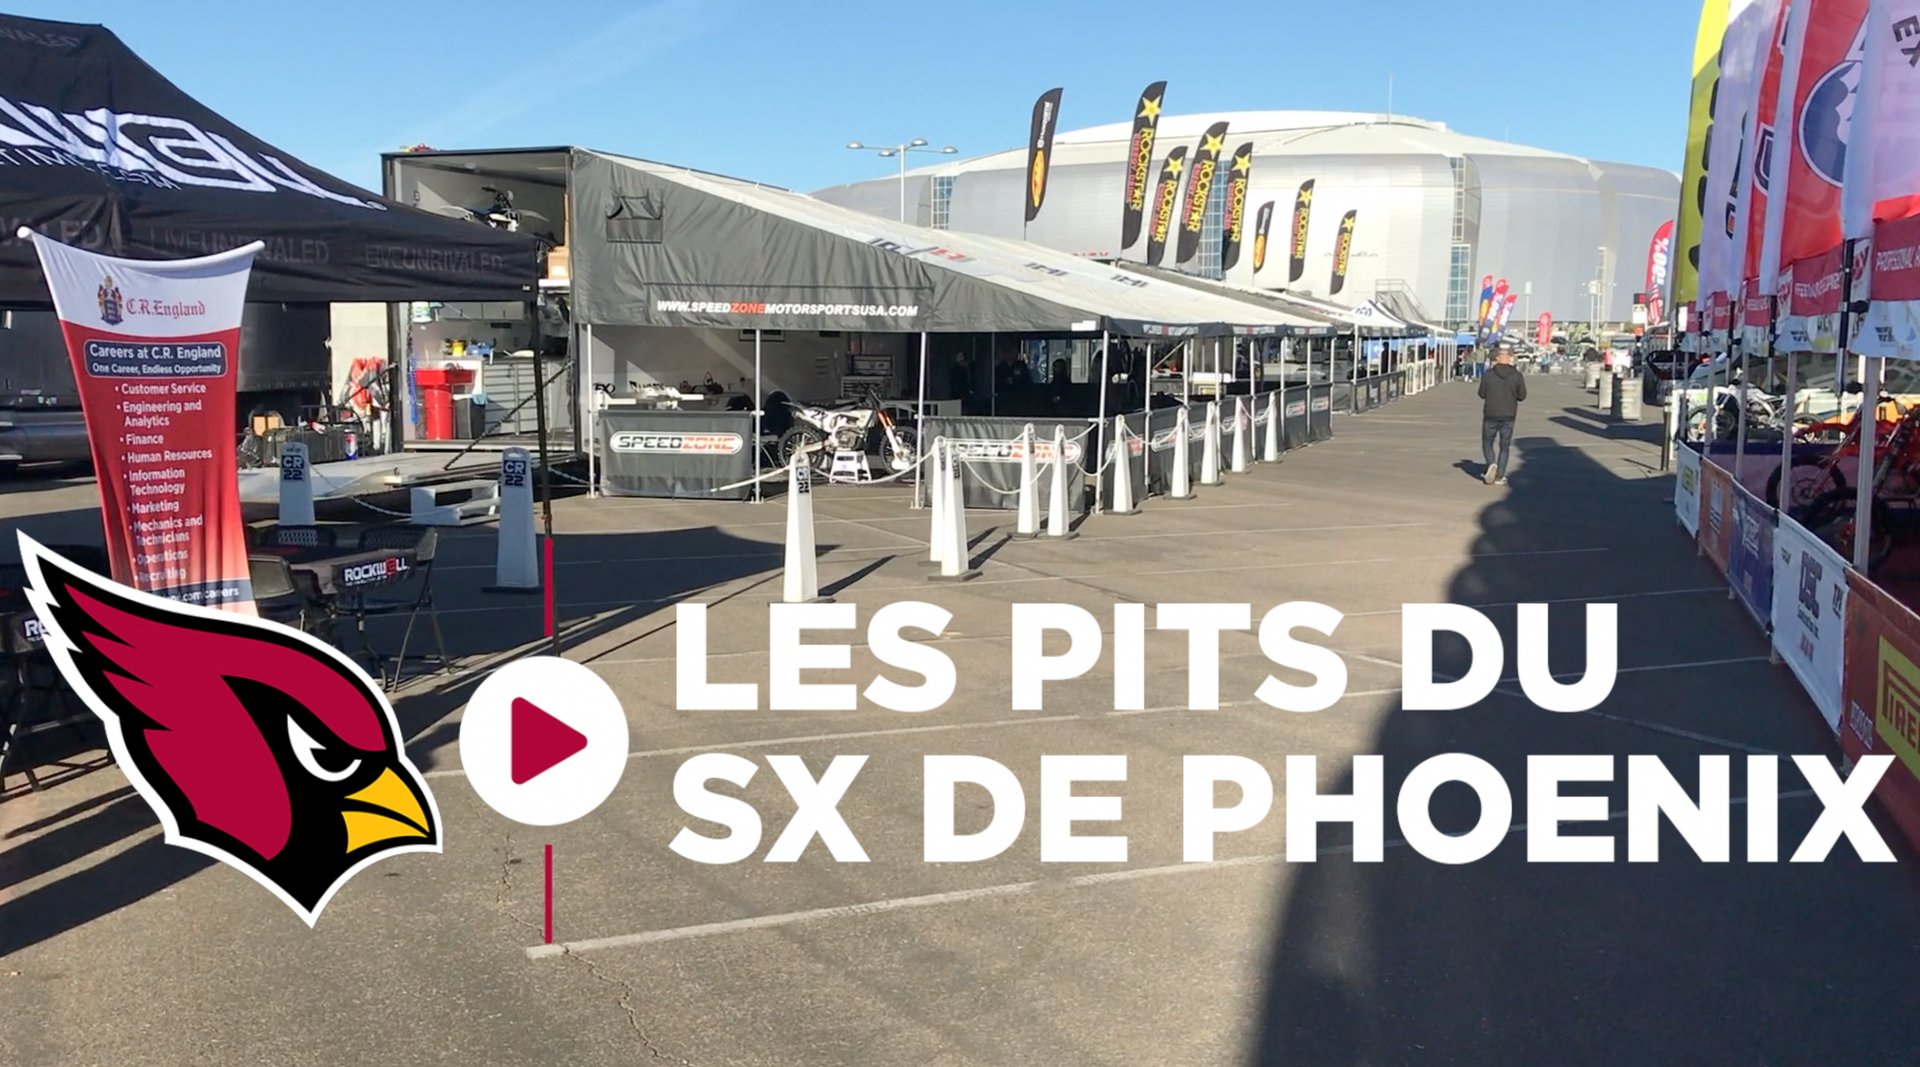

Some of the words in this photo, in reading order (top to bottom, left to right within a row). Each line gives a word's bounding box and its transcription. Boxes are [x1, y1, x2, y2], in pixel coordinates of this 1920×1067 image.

[657, 300, 919, 317] WWW.SPEEDZONEMOTORSPORTSUSA.COM
[89, 344, 134, 359] Careers
[137, 348, 149, 359] at
[151, 347, 174, 360] C.R.
[177, 346, 222, 361] England
[92, 365, 110, 374] One
[111, 364, 140, 376] Career,
[142, 366, 173, 375] Endless
[174, 363, 222, 375] Opportunity
[121, 383, 169, 395] Customer
[171, 383, 206, 395] Service
[123, 401, 182, 415] Engineering
[184, 400, 202, 411] and
[124, 416, 170, 429] Analytics
[126, 434, 164, 445] Finance
[127, 453, 162, 464] Human
[164, 450, 213, 462] Resources
[282, 456, 304, 469] CR
[129, 468, 185, 482] Information
[284, 469, 303, 480] 22
[504, 461, 526, 475] CR
[504, 475, 525, 486] 22
[130, 482, 185, 496] Technology
[132, 500, 179, 514] Marketing
[134, 518, 182, 533] Mechanics
[185, 515, 203, 528] and
[136, 531, 189, 546] Technicians
[344, 557, 408, 582] ROCKWELL
[1882, 660, 1920, 755] PIRE
